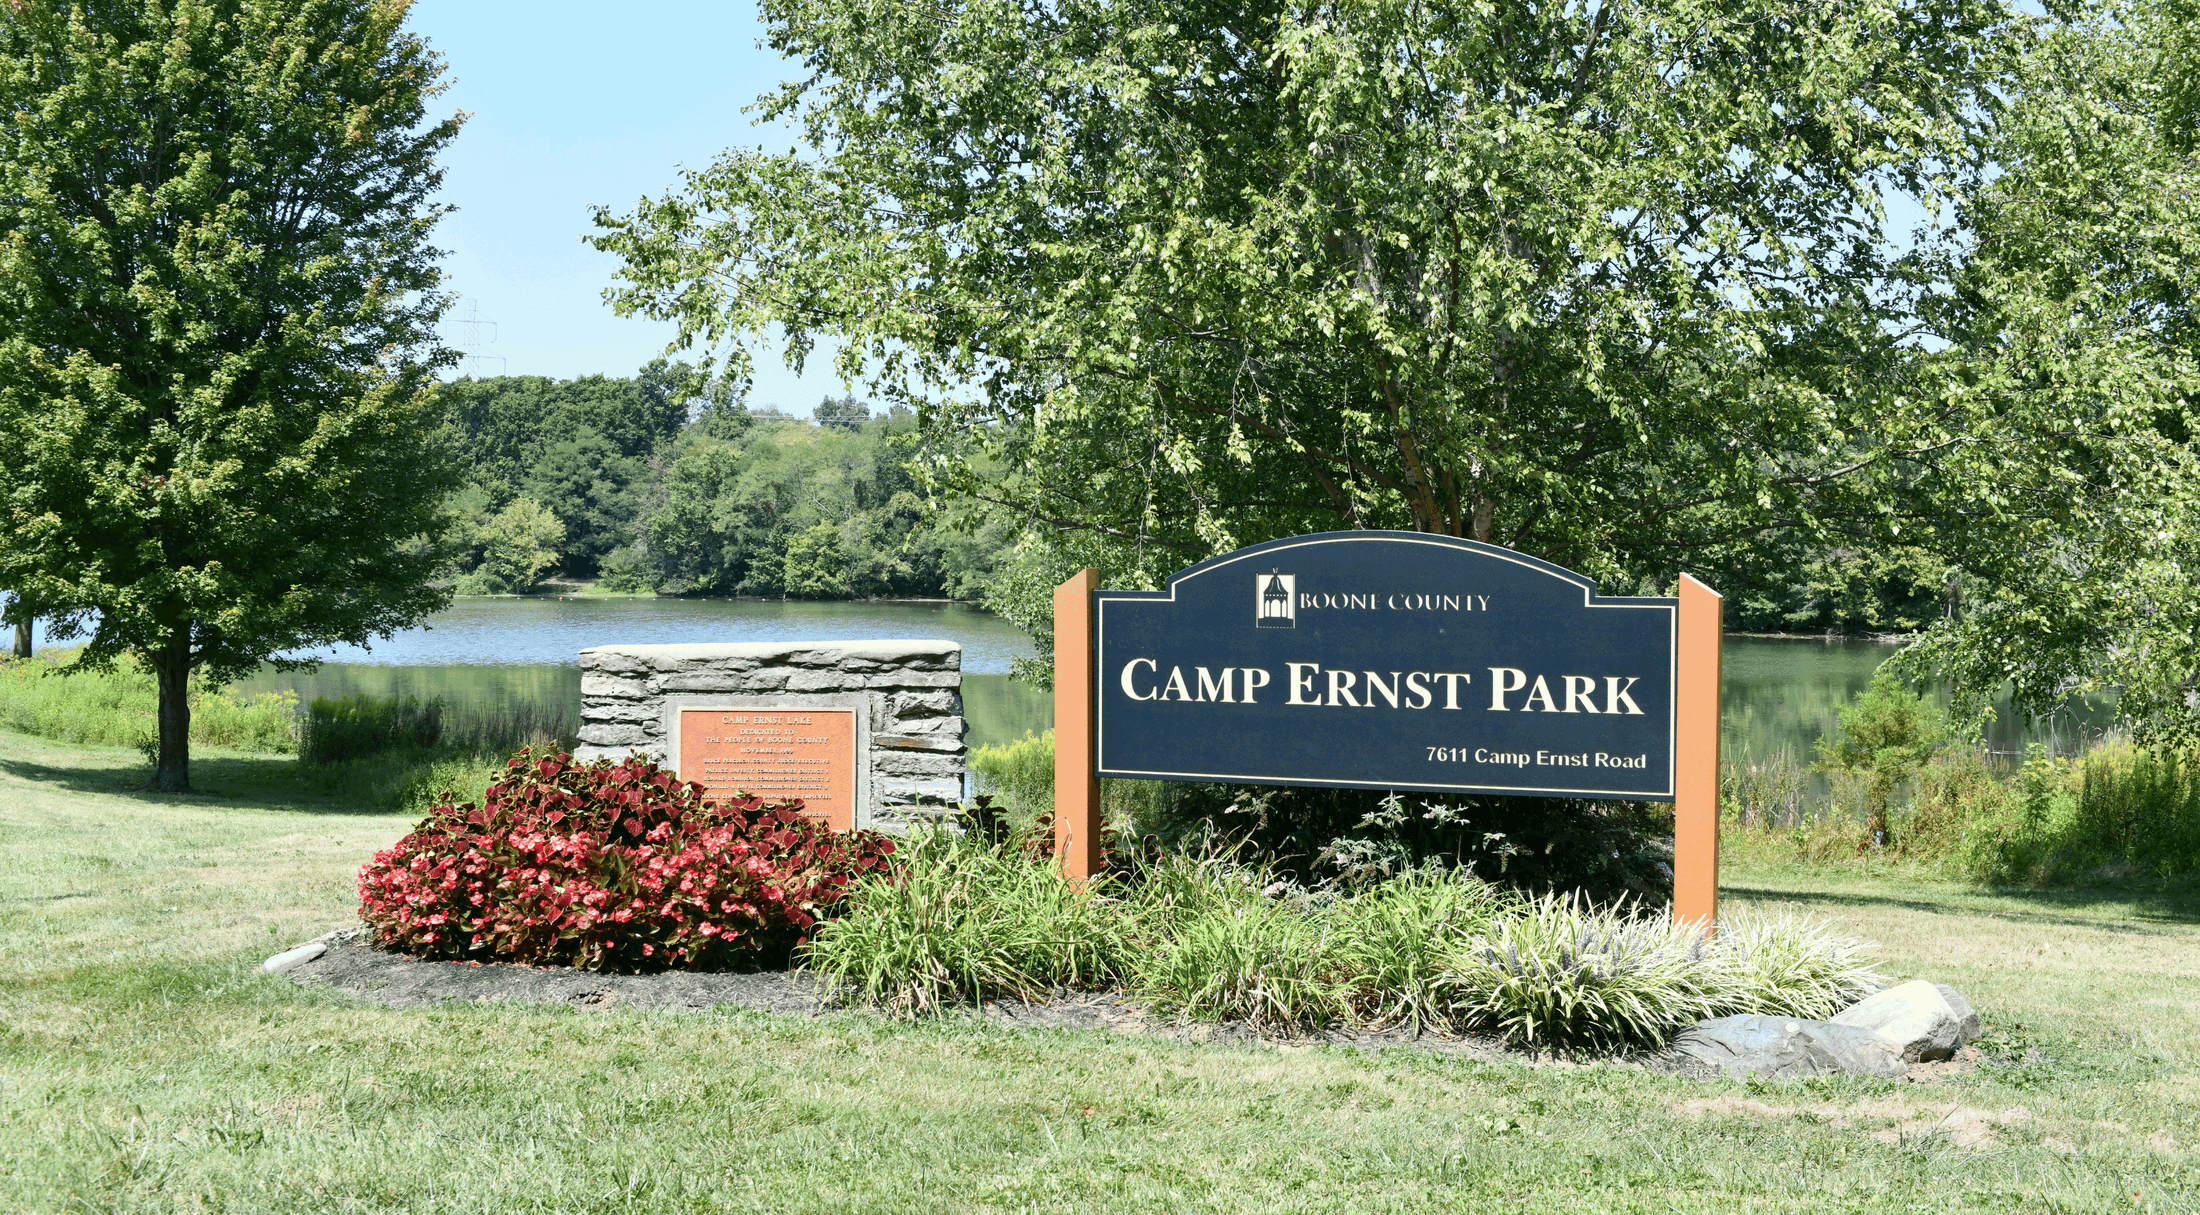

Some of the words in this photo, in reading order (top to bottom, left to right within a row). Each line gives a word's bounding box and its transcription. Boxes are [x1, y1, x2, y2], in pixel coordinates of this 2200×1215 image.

[1300, 592, 1382, 612] BOONE
[1388, 592, 1491, 613] COUNTY
[1120, 657, 1270, 704] CAMP
[1284, 661, 1472, 711] ERNST
[1487, 666, 1645, 716] PARK
[722, 716, 749, 725] CAMP
[753, 716, 782, 725] ERNST
[787, 716, 812, 725] LAKE
[797, 736, 829, 744] COUNTY
[1426, 746, 1468, 764] 7611
[1475, 748, 1531, 769] Camp
[1537, 749, 1588, 768] Ernst
[1595, 751, 1646, 770] Road
